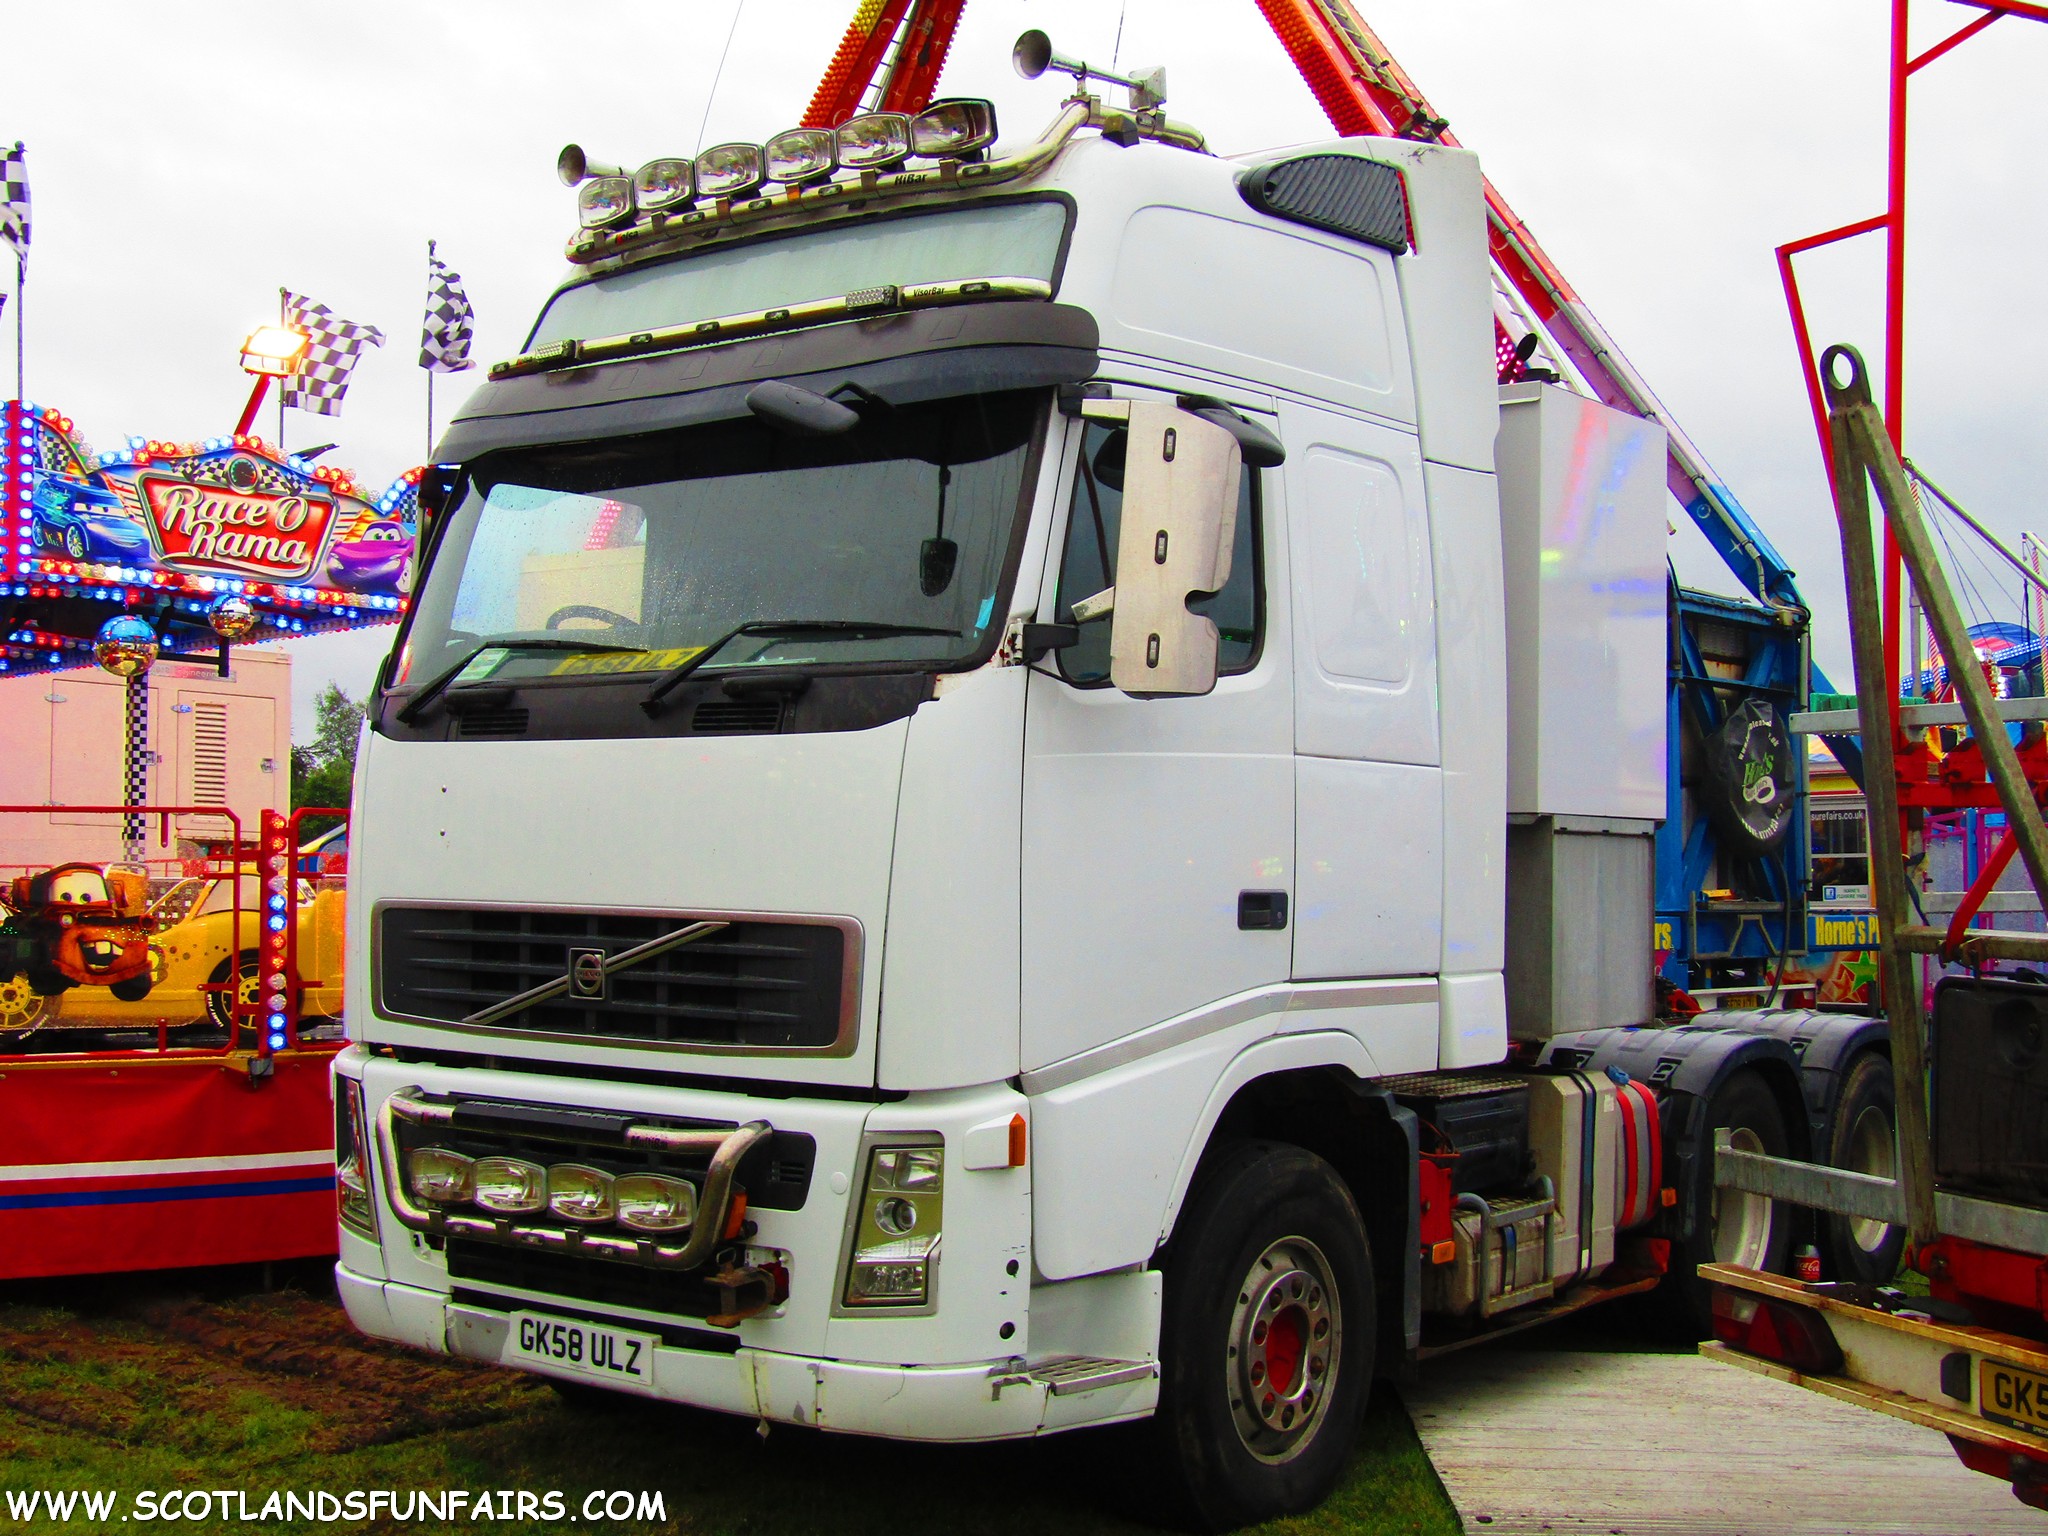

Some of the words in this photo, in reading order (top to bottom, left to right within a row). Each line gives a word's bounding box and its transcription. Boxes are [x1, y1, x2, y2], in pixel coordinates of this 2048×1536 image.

[894, 172, 929, 186] HiBar
[912, 286, 946, 298] VisorBar
[159, 485, 268, 536] Race
[274, 495, 310, 532] O
[187, 519, 312, 564] Rama
[1815, 916, 1867, 946] Horne's
[520, 1317, 583, 1362] GK58
[591, 1332, 642, 1376] ULZ
